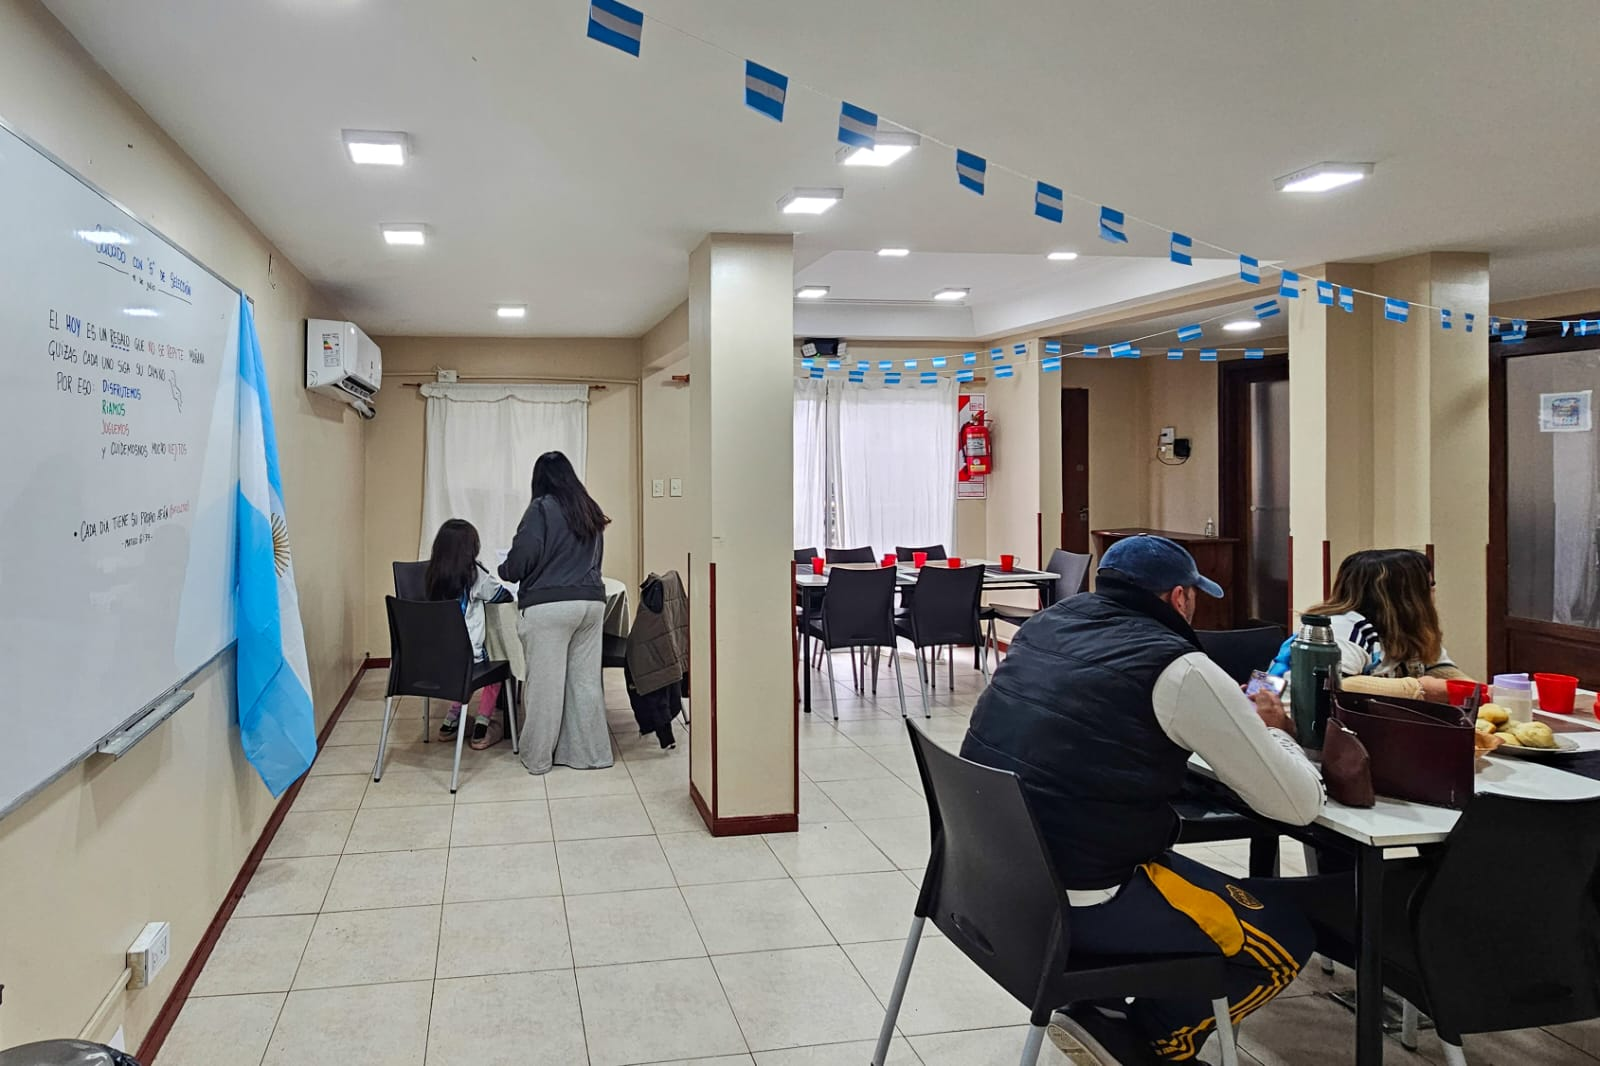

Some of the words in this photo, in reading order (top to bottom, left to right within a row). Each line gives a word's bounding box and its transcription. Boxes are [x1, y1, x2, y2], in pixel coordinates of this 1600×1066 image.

[49, 309, 59, 330] EL
[66, 313, 81, 337] HOY
[87, 322, 96, 341] ES
[99, 327, 107, 341] UN
[109, 328, 130, 347] REGALO
[148, 341, 155, 355] NO
[158, 343, 165, 357] SE
[83, 350, 98, 367] CADA
[102, 356, 114, 370] UNO
[136, 362, 143, 377] SU
[57, 371, 72, 393] POR
[80, 520, 98, 543] CADA
[131, 512, 138, 528] SU
